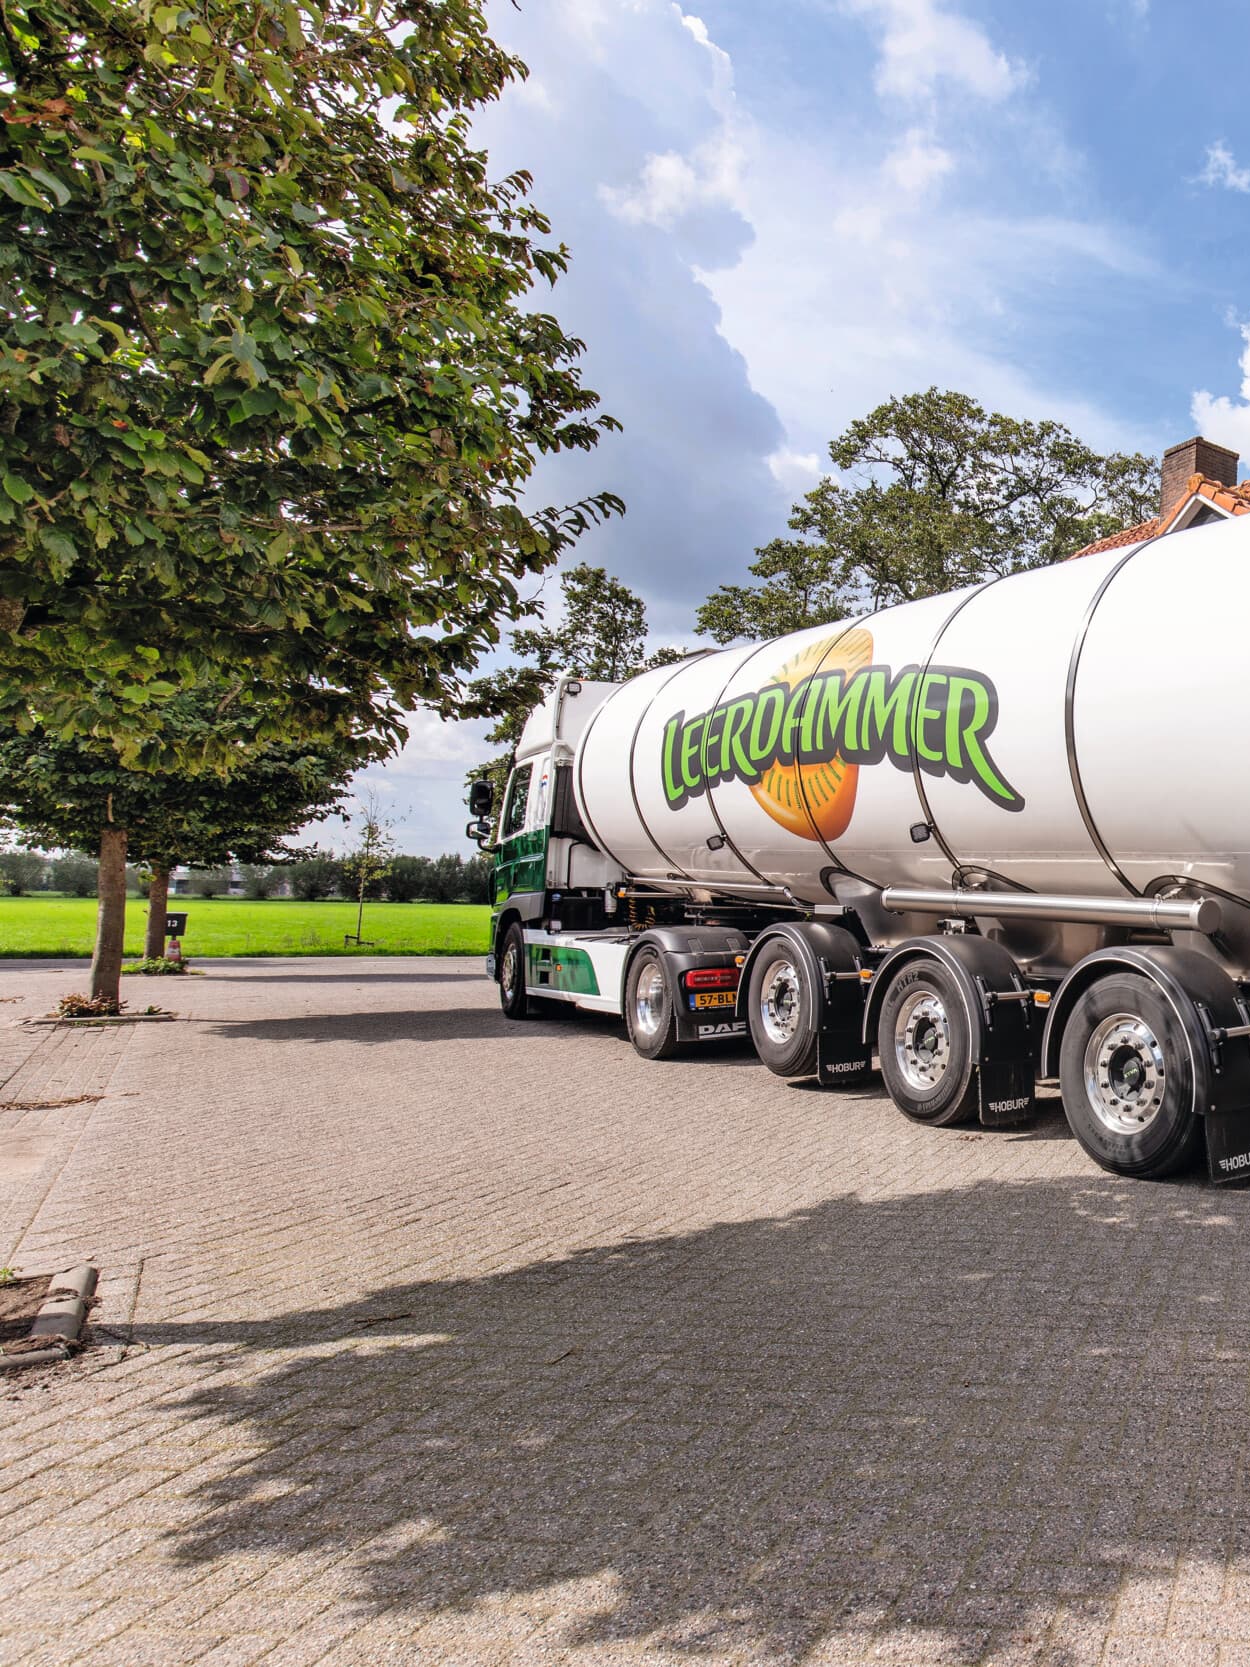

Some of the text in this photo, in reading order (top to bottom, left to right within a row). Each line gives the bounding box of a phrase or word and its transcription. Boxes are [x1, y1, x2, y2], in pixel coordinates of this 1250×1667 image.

[662, 669, 1017, 802] LEERDAMMER
[167, 919, 178, 928] 13
[698, 1021, 747, 1035] DAF
[831, 1060, 861, 1073] HOBUR
[994, 1097, 1025, 1113] HOBUR
